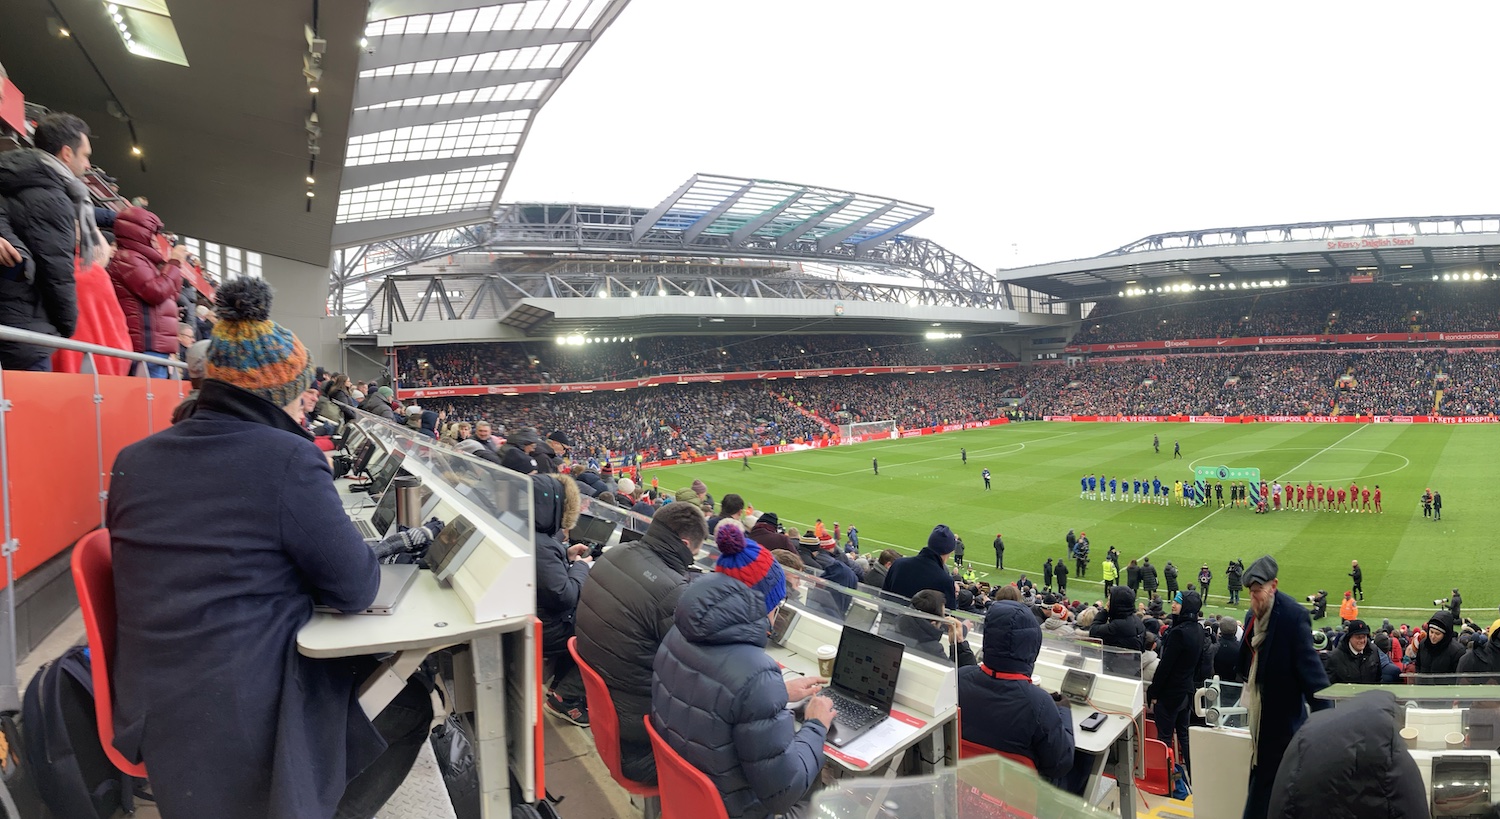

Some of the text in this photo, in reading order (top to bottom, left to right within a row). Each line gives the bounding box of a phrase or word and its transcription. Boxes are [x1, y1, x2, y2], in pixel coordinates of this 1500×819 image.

[1327, 241, 1336, 250] Sir
[1361, 239, 1391, 248] Dalglish
[1393, 237, 1414, 246] Stand
[568, 708, 582, 719] N
